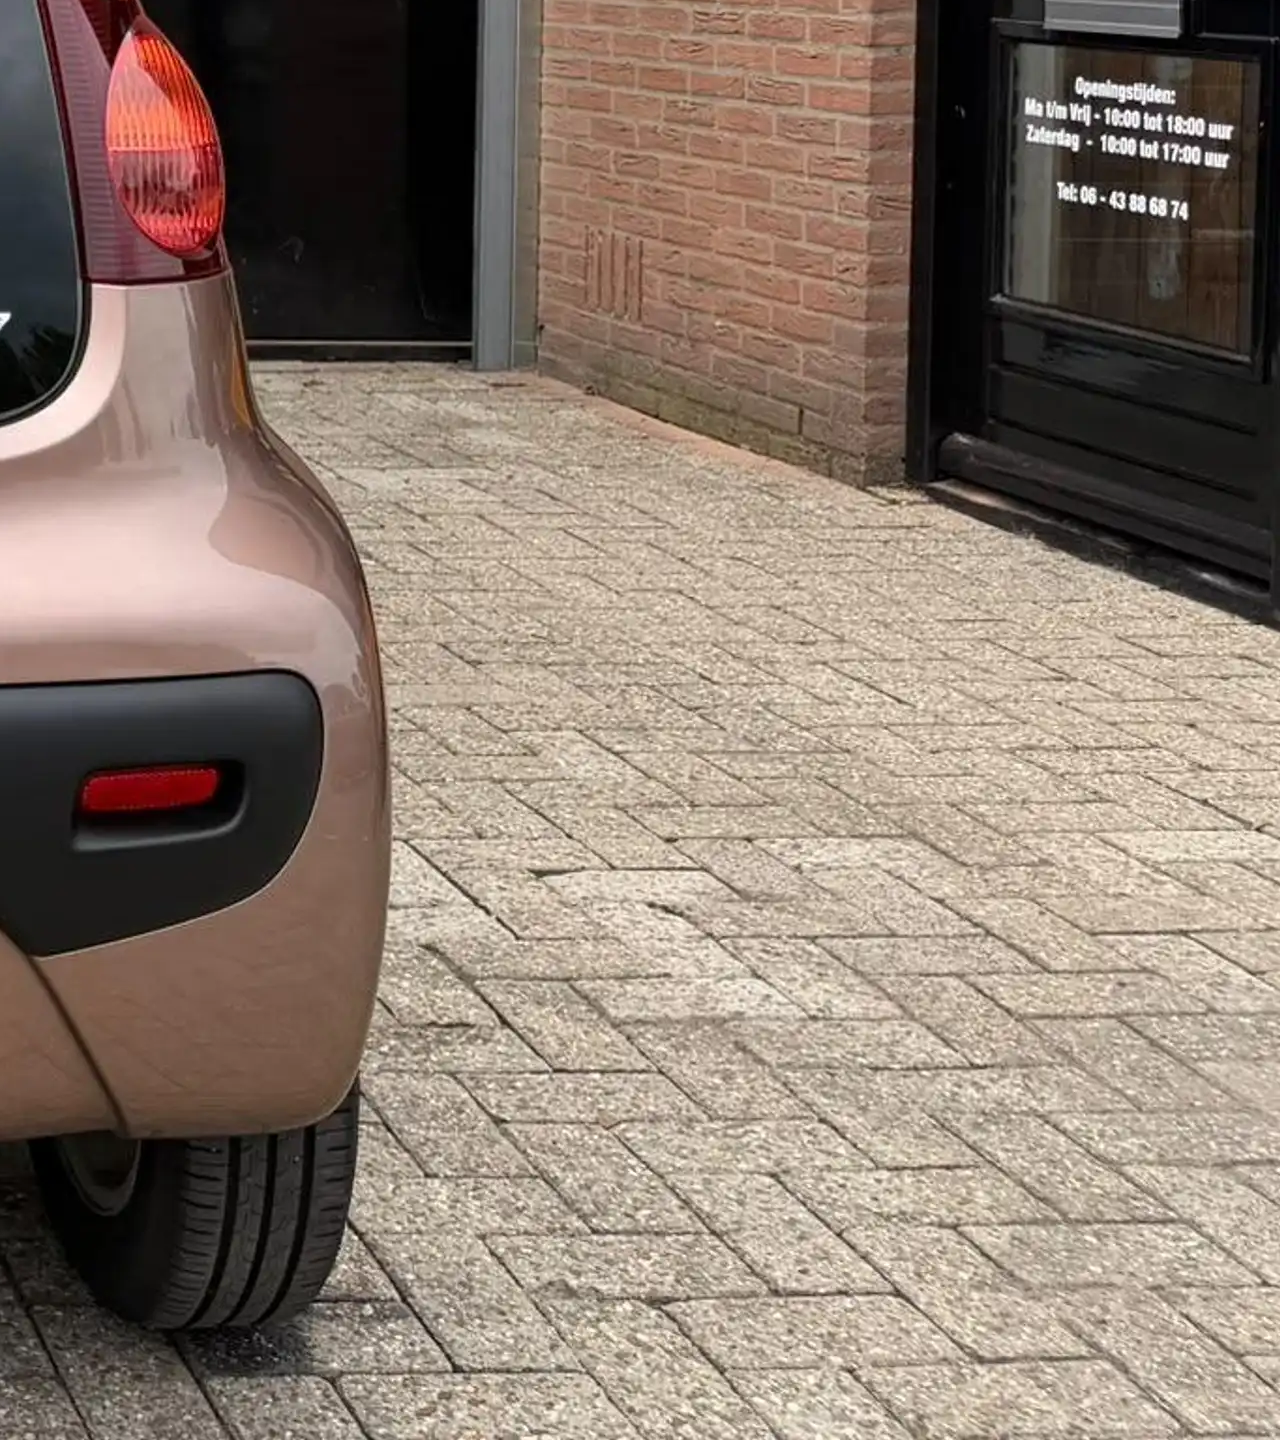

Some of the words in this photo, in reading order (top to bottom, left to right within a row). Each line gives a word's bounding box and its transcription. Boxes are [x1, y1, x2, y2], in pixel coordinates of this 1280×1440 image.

[1074, 76, 1177, 106] Openingstijden:
[1069, 102, 1092, 127] Vrij
[1103, 107, 1141, 129] 10:00
[1143, 111, 1164, 133] tot
[1165, 114, 1206, 137] 18:00
[1208, 123, 1234, 140] uur
[1025, 123, 1080, 152] Zaterdag
[1100, 134, 1137, 157] 10:00
[1139, 139, 1160, 160] tot
[1162, 142, 1202, 165] 17:00
[1204, 151, 1230, 169] uur
[1056, 181, 1078, 202] Tel:
[1109, 190, 1126, 210] 43
[1170, 200, 1189, 221] 74
